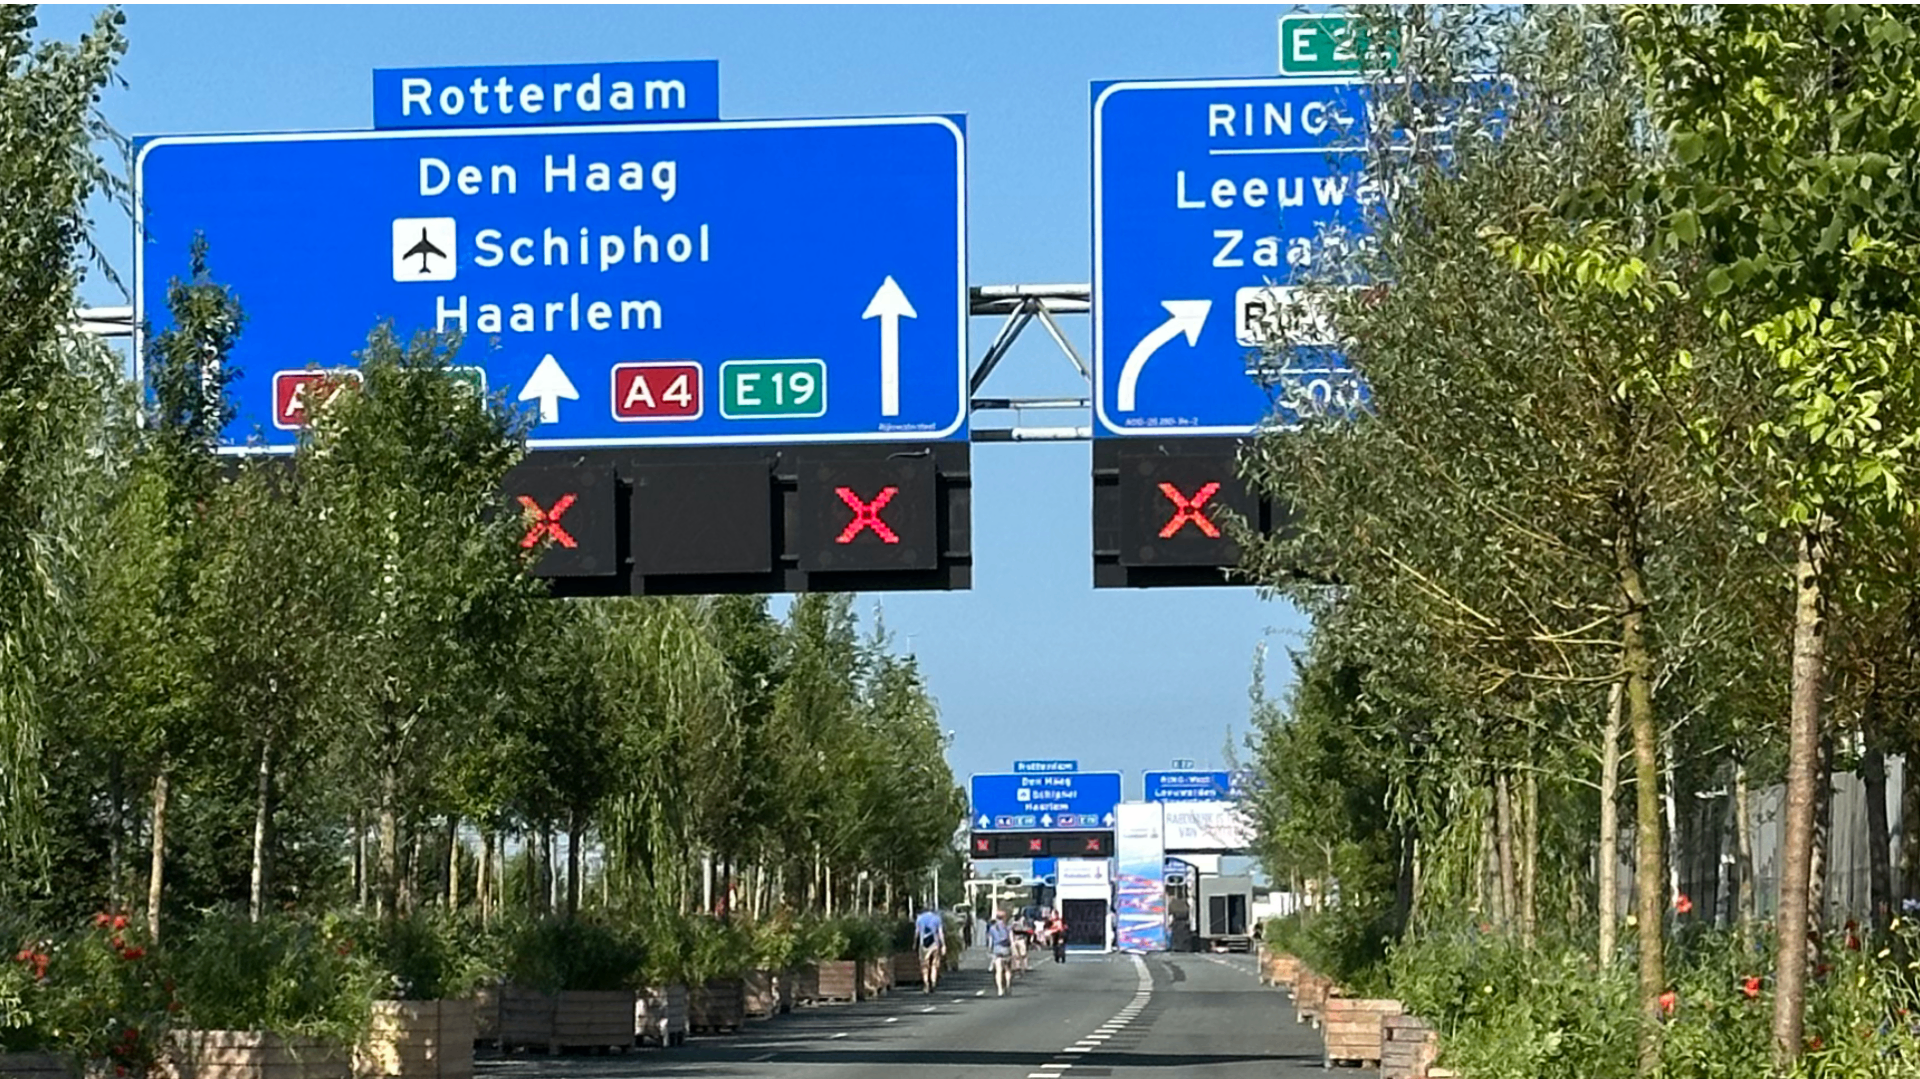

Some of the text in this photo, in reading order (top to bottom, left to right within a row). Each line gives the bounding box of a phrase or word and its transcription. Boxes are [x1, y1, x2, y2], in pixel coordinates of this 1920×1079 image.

[402, 74, 687, 116] Rotterdam
[419, 154, 677, 202] Den Haag
[474, 224, 710, 272] Schiphol
[436, 293, 663, 335] Haarlem
[623, 374, 692, 409] A4
[737, 372, 815, 406] E19
